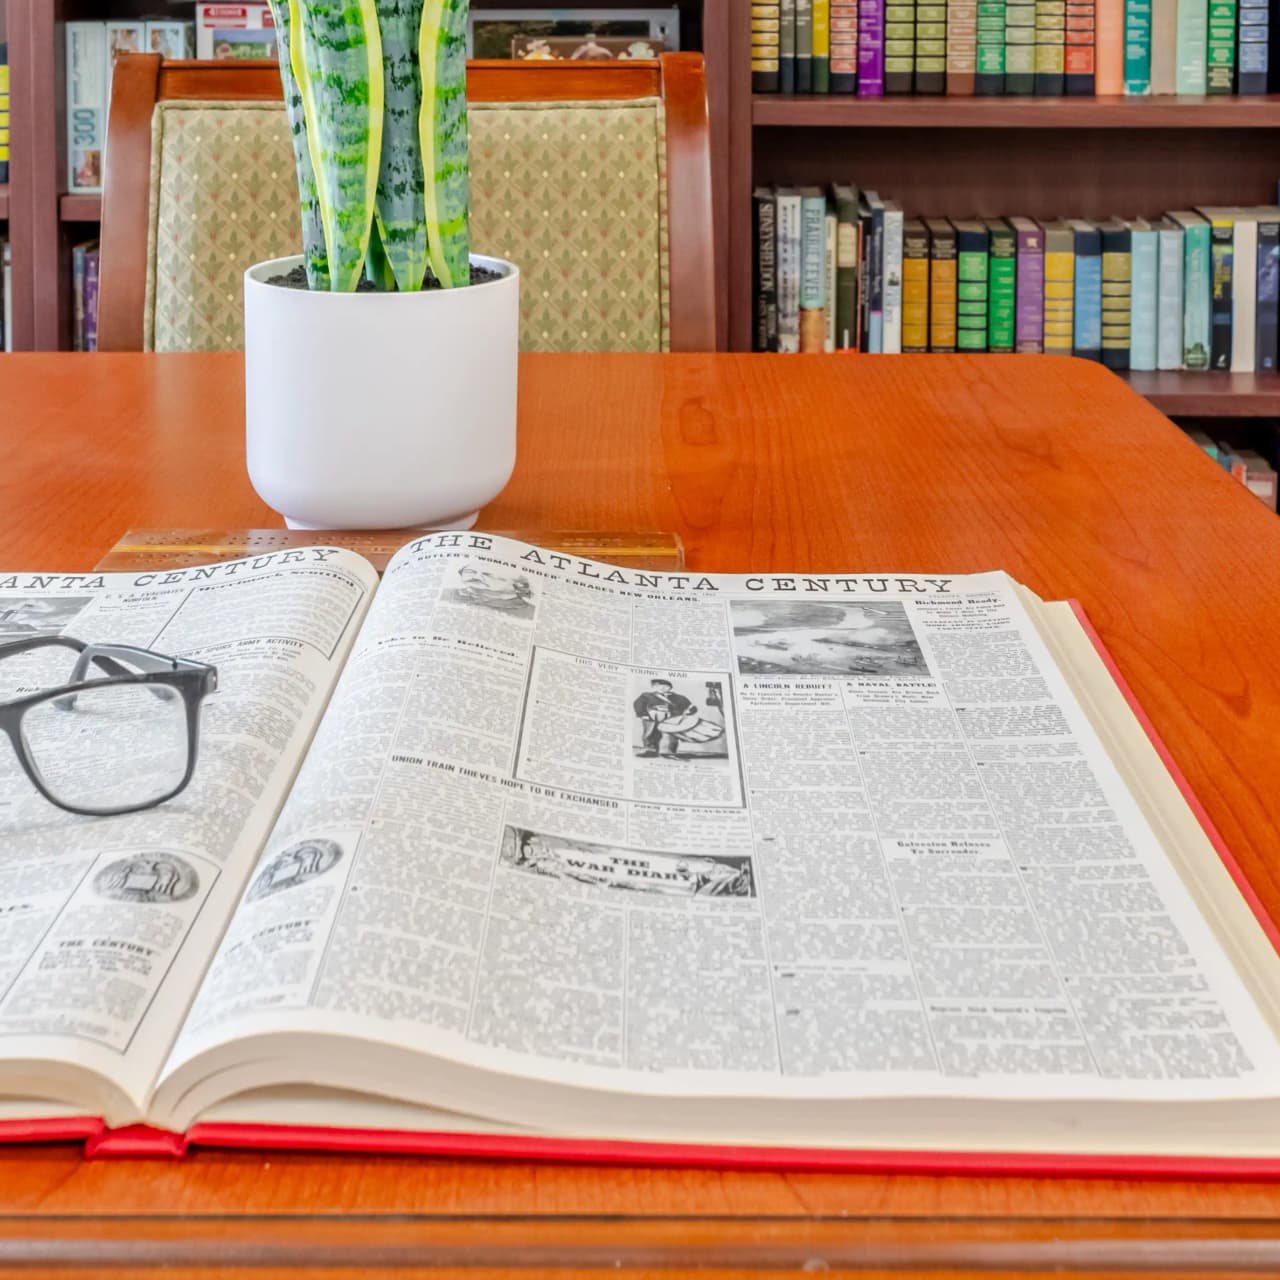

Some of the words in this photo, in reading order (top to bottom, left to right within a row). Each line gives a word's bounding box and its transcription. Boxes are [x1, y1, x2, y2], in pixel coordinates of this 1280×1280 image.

[73, 108, 96, 146] 300
[805, 209, 820, 257] PRAIRIE
[761, 241, 775, 291] SHELDON
[805, 261, 820, 301] FEVER
[133, 549, 340, 587] CENTURY
[410, 535, 494, 553] THE
[520, 549, 720, 591] ATLANTA
[745, 578, 955, 592] CENTURY
[392, 754, 423, 766] UNION
[426, 759, 457, 773] TRAIN
[458, 766, 497, 784] THIEVES
[500, 778, 524, 792] HOPE
[529, 786, 542, 795] TO
[544, 789, 556, 798] BE
[566, 858, 615, 874] WAR
[627, 868, 696, 882] DIARY
[609, 856, 650, 869] THE
[59, 939, 83, 948] THE
[92, 937, 154, 956] CENTURY
